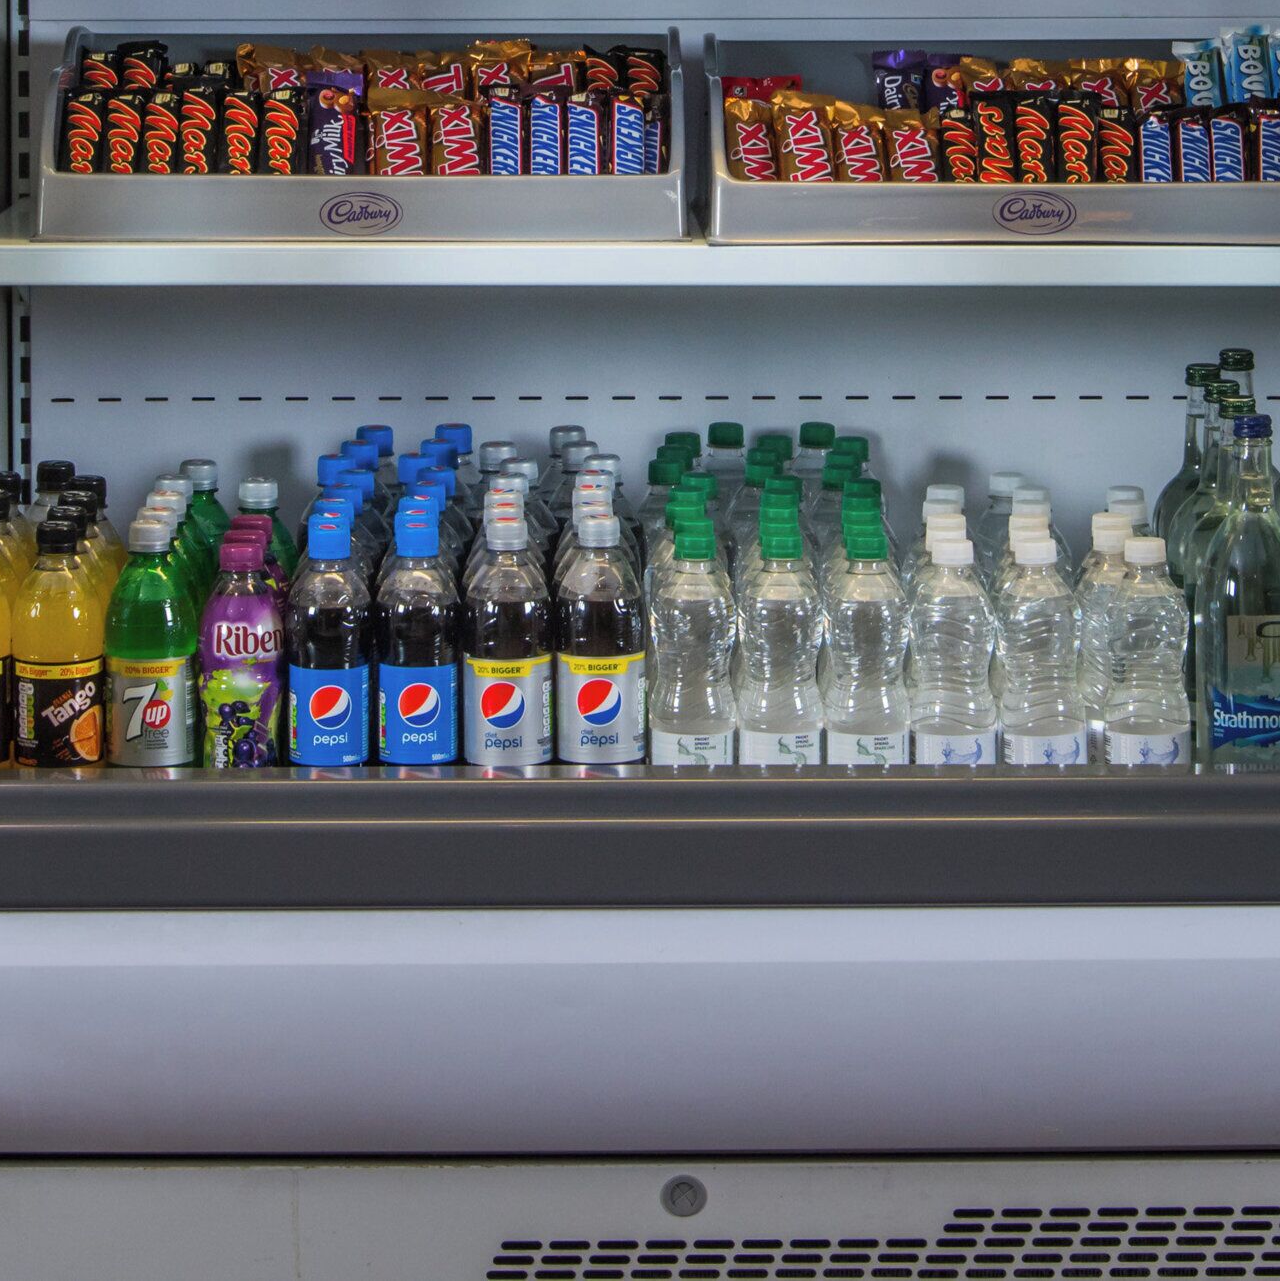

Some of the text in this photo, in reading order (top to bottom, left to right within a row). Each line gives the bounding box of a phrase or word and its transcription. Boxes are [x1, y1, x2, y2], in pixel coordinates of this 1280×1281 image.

[327, 199, 392, 224] Cadbury
[999, 199, 1065, 224] Cadbury
[215, 622, 285, 657] Riben
[75, 665, 95, 676] Bigger
[141, 665, 169, 675] BIGGER
[490, 665, 521, 675] BIGGER
[587, 662, 618, 672] BIGGER
[41, 681, 96, 727] Tango
[143, 728, 170, 739] free
[313, 732, 349, 747] pepsi
[402, 730, 438, 745] pepsi
[484, 731, 498, 739] diet
[580, 732, 619, 748] pepsi
[485, 735, 523, 751] pepsi
